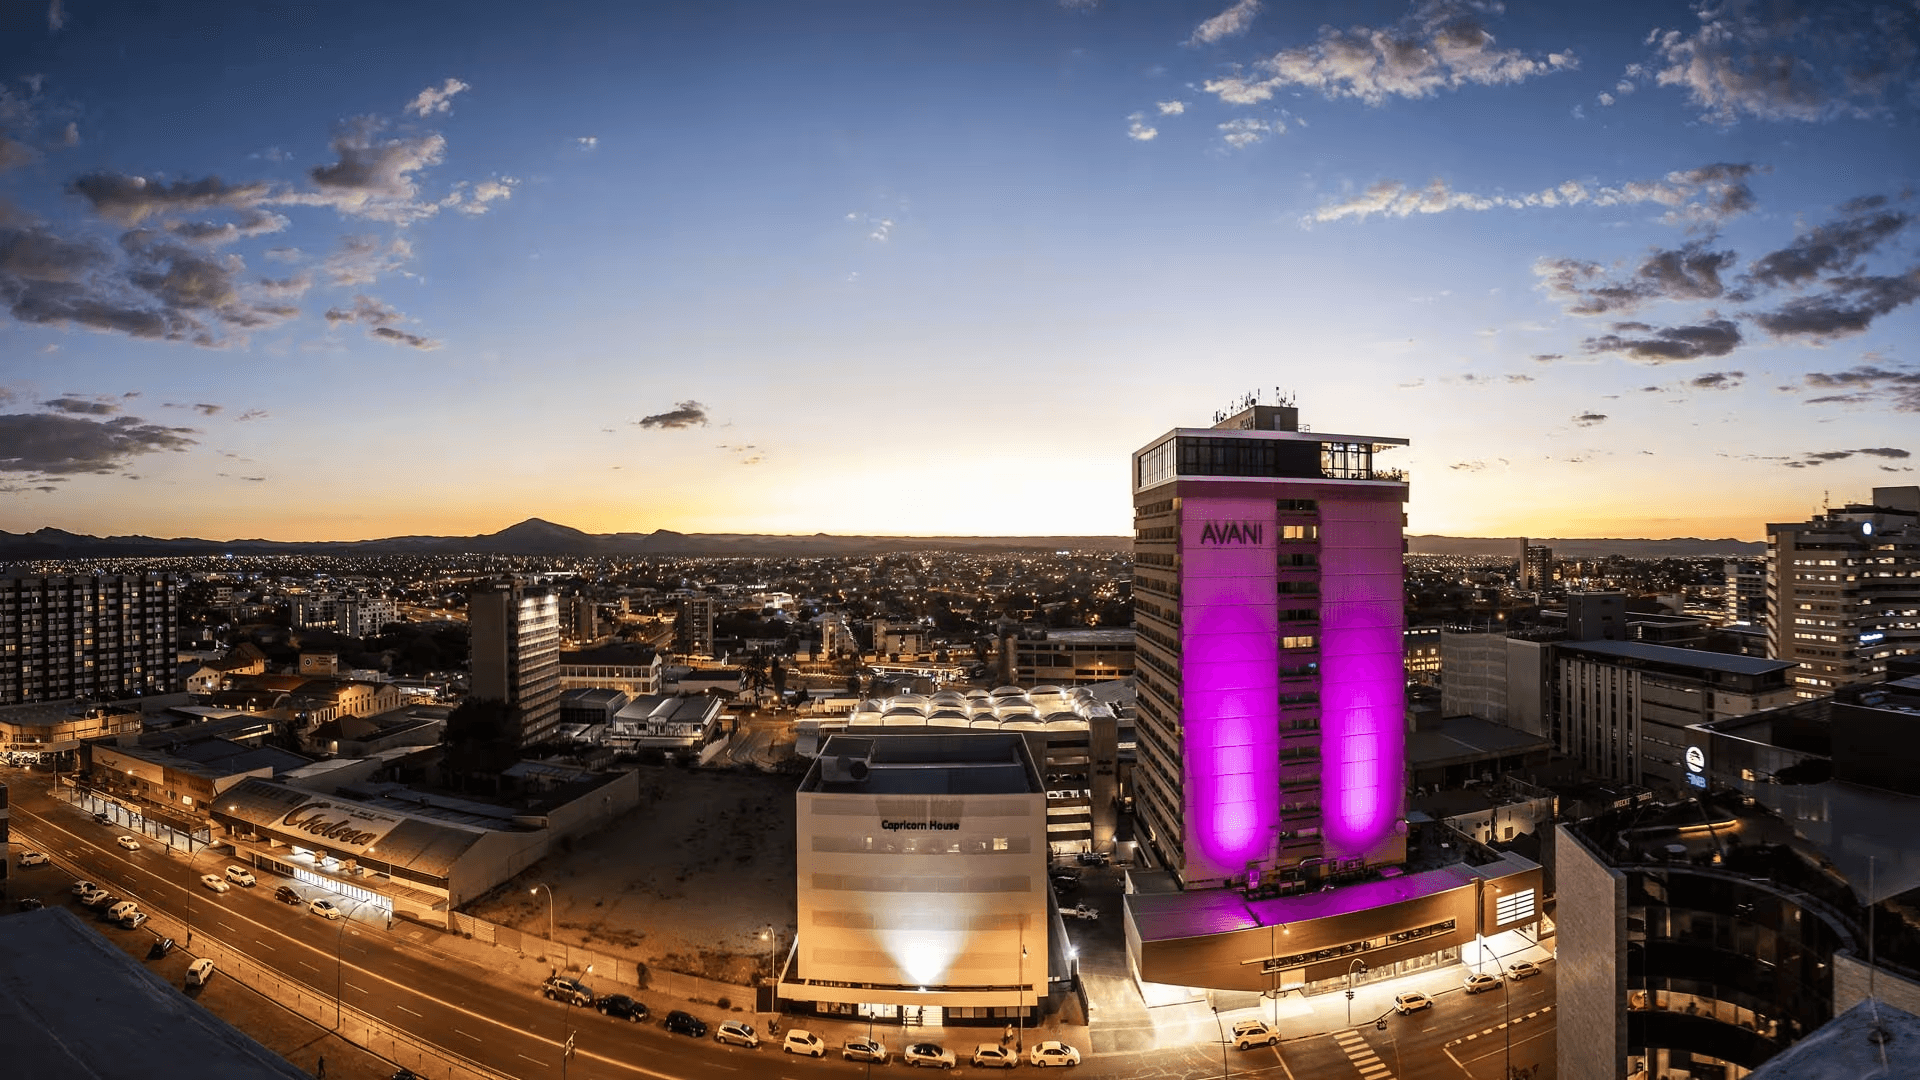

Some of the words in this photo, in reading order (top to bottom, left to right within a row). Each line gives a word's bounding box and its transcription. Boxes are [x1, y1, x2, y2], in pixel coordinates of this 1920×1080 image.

[1200, 523, 1262, 544] AVANI
[283, 803, 376, 846] Chelsea
[881, 820, 926, 832] Capricorn
[929, 820, 960, 830] House
